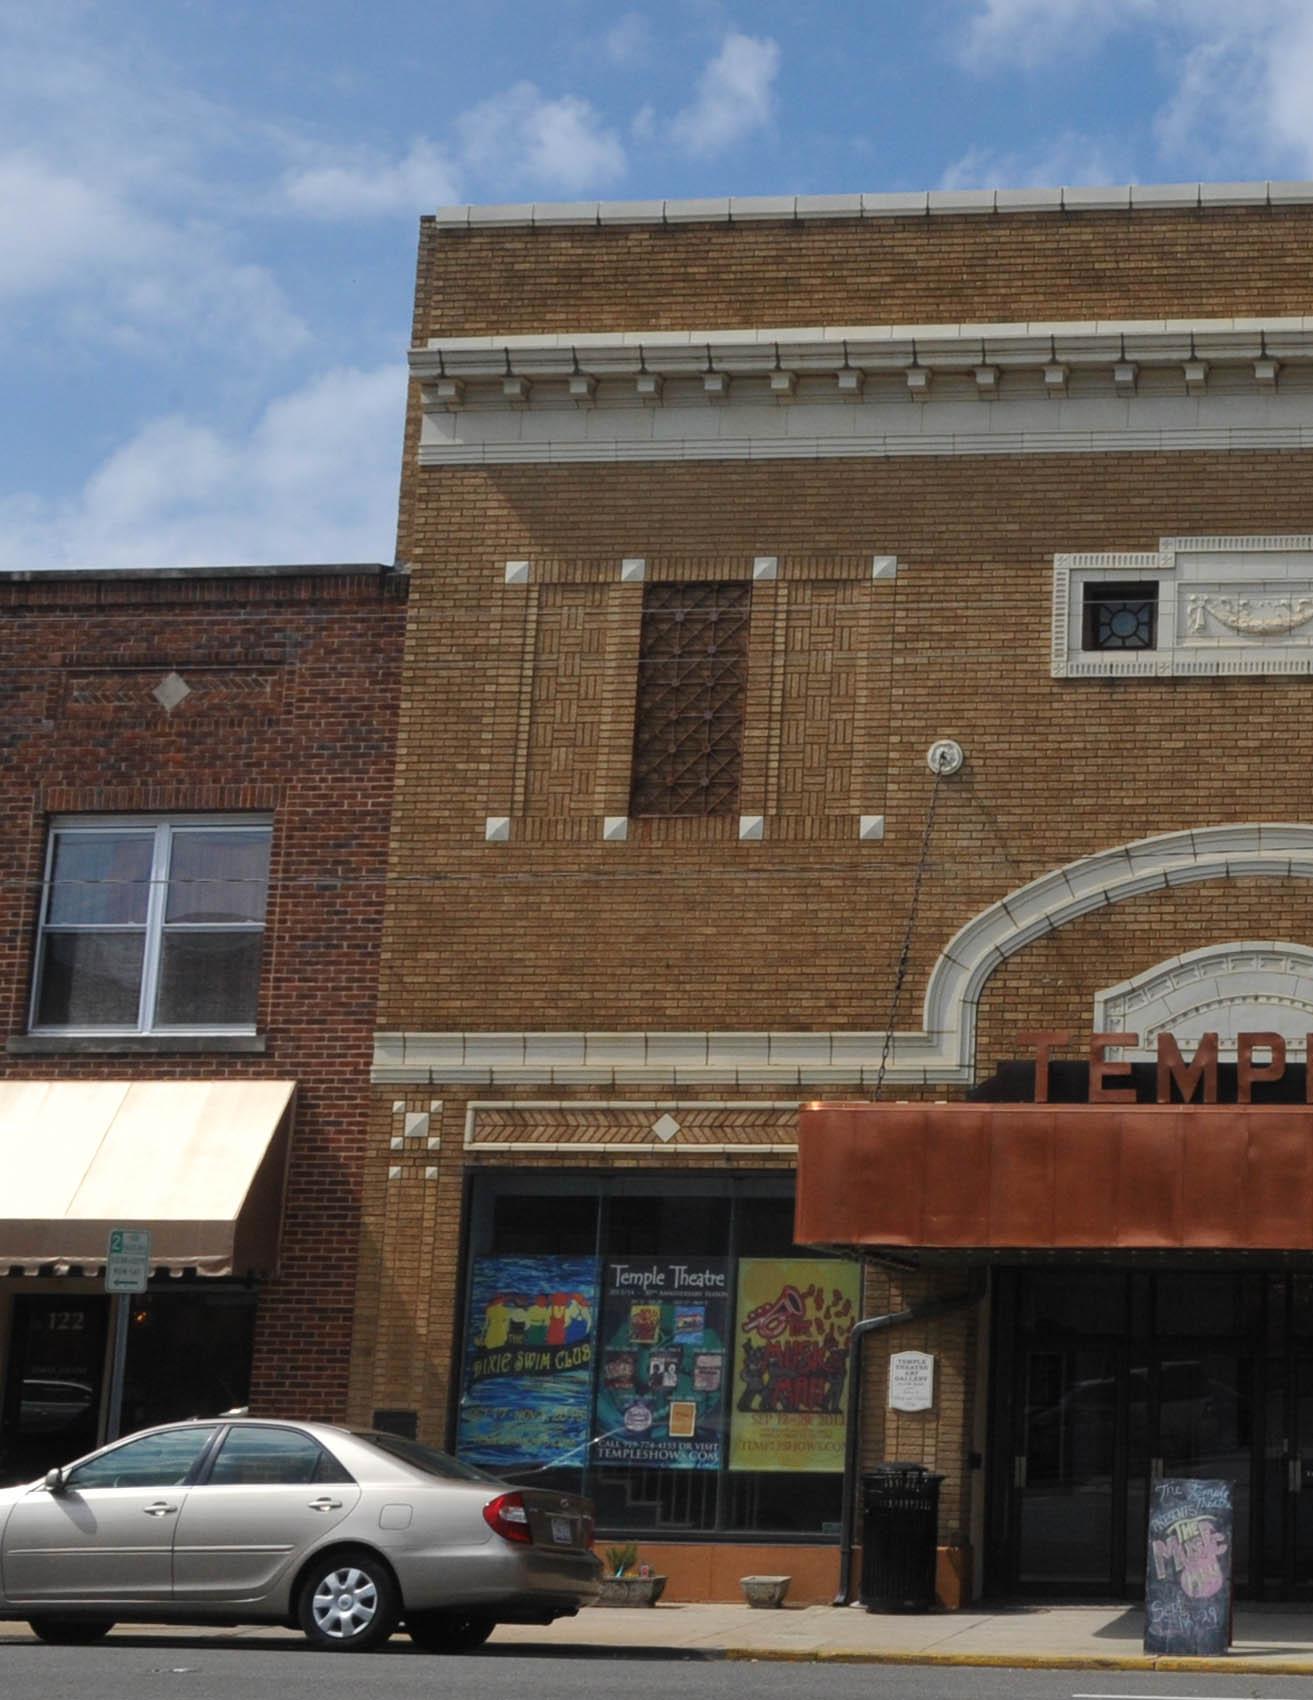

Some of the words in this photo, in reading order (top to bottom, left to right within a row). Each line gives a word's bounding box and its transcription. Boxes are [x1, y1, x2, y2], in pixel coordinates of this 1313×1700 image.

[112, 1234, 121, 1250] 2
[610, 1264, 665, 1290] Temple
[669, 1265, 726, 1288] Theatre
[48, 1312, 84, 1330] 122
[473, 1352, 512, 1378] DIXIE
[514, 1351, 551, 1373] SWIM
[554, 1343, 593, 1369] CLUB
[598, 1439, 620, 1448] CALL
[694, 1442, 720, 1450] VISIT
[598, 1448, 720, 1461] TEMPLESHOWS.COM
